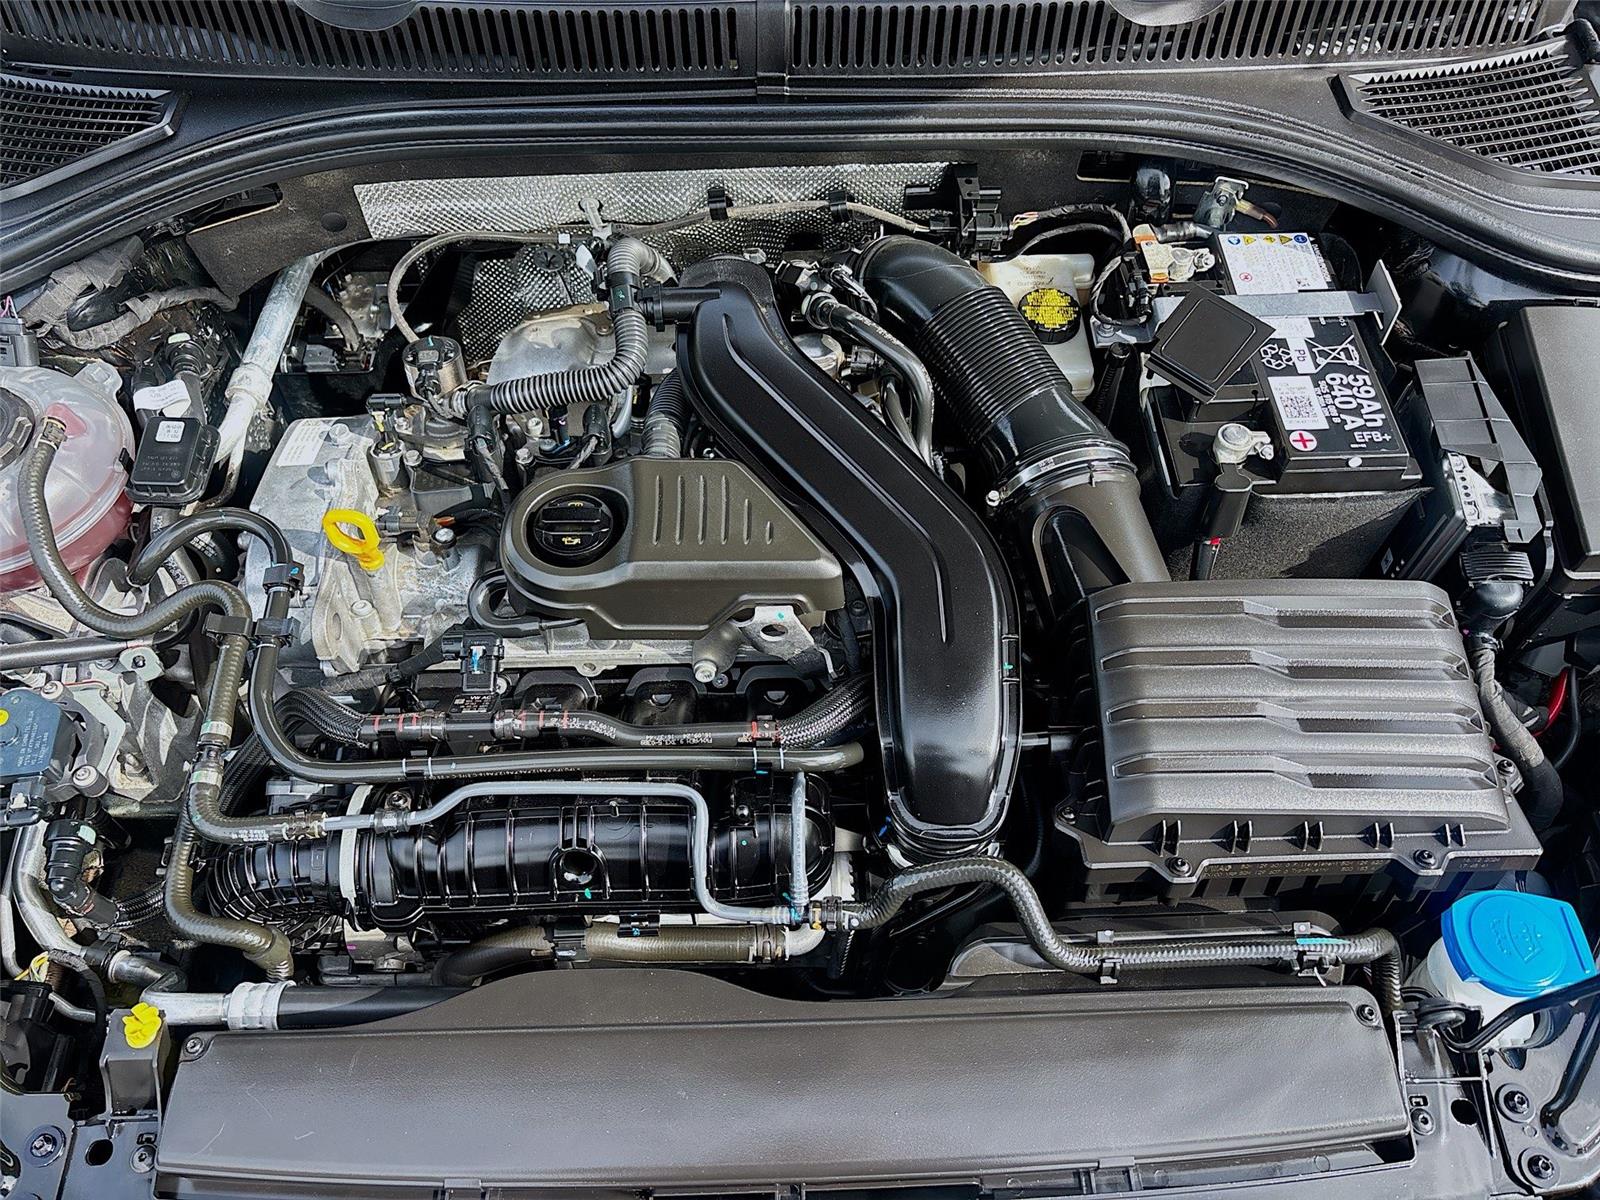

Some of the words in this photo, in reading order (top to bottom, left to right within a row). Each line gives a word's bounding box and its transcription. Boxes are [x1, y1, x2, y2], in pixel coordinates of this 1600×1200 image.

[1295, 349, 1306, 361] Pb
[1325, 373, 1358, 409] 640
[1347, 374, 1386, 427] 59Ah
[1339, 413, 1366, 430] A
[1353, 431, 1392, 443] EFB+
